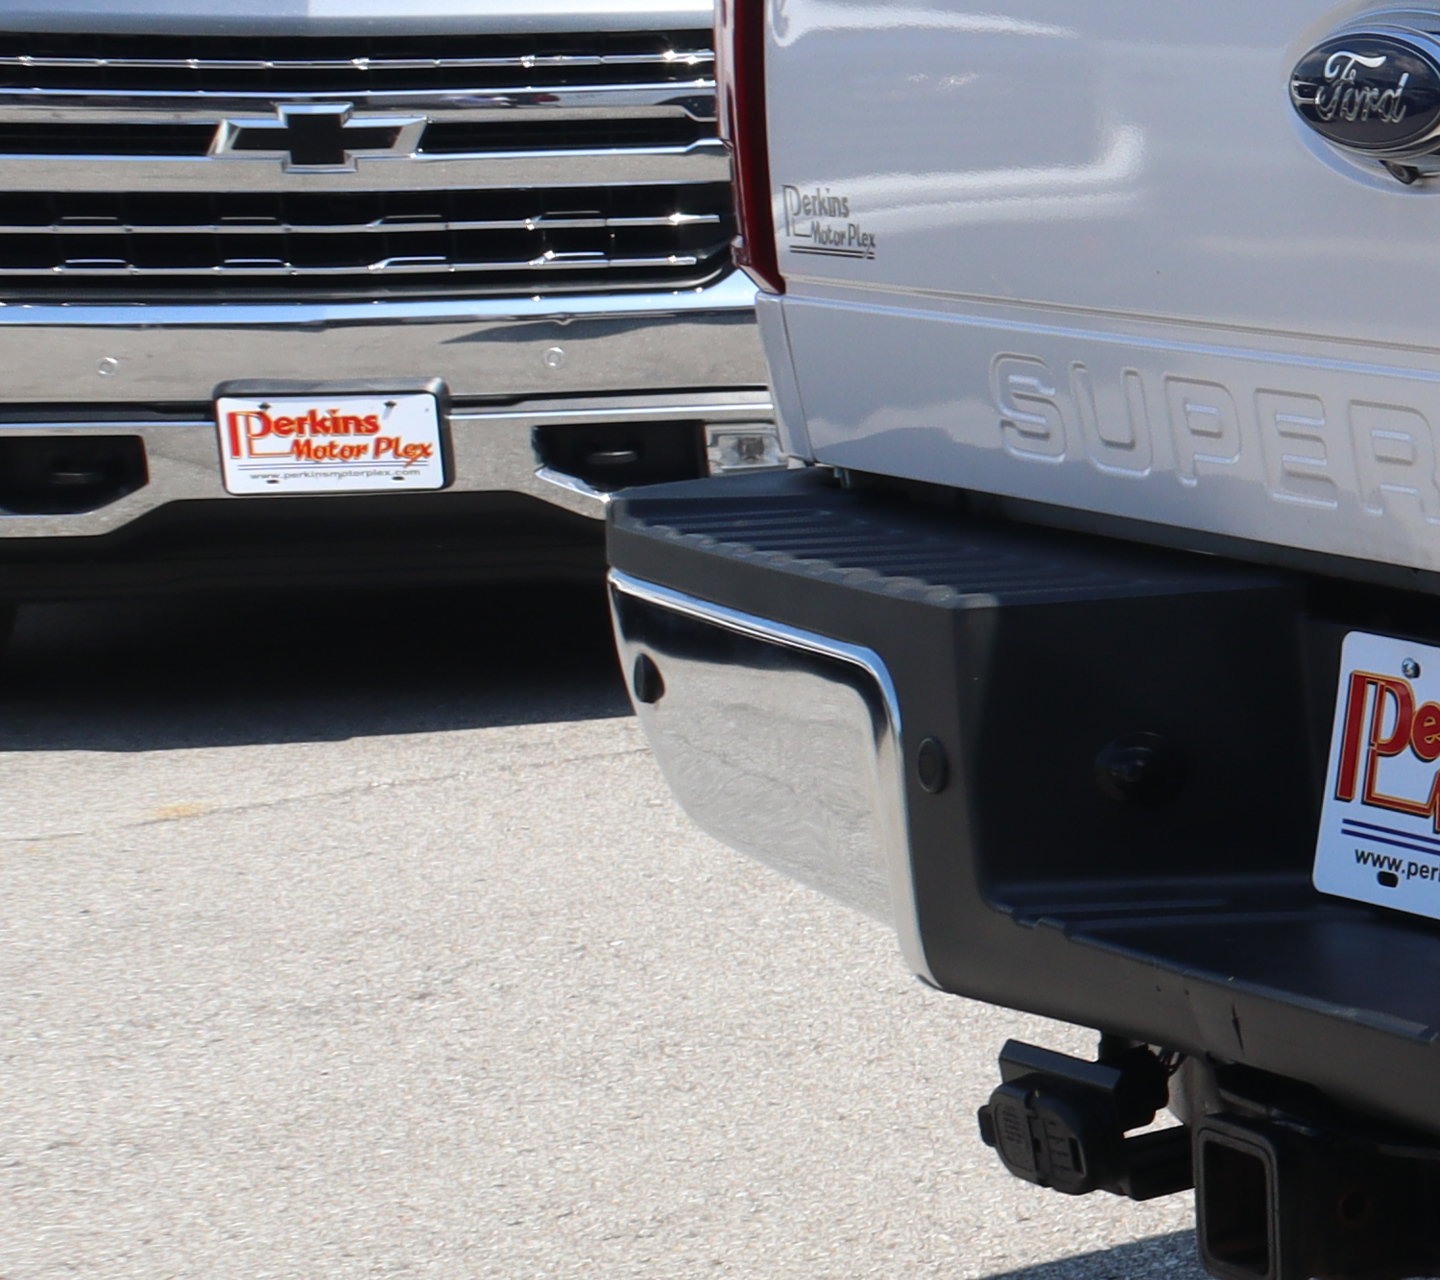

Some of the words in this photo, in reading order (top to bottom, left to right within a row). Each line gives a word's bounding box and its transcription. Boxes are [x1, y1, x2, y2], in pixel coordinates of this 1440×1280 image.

[1316, 50, 1410, 123] Ford
[782, 185, 850, 237] Perkins
[226, 408, 380, 460] Perkins
[291, 437, 368, 463] Motor
[371, 436, 434, 468] Plex
